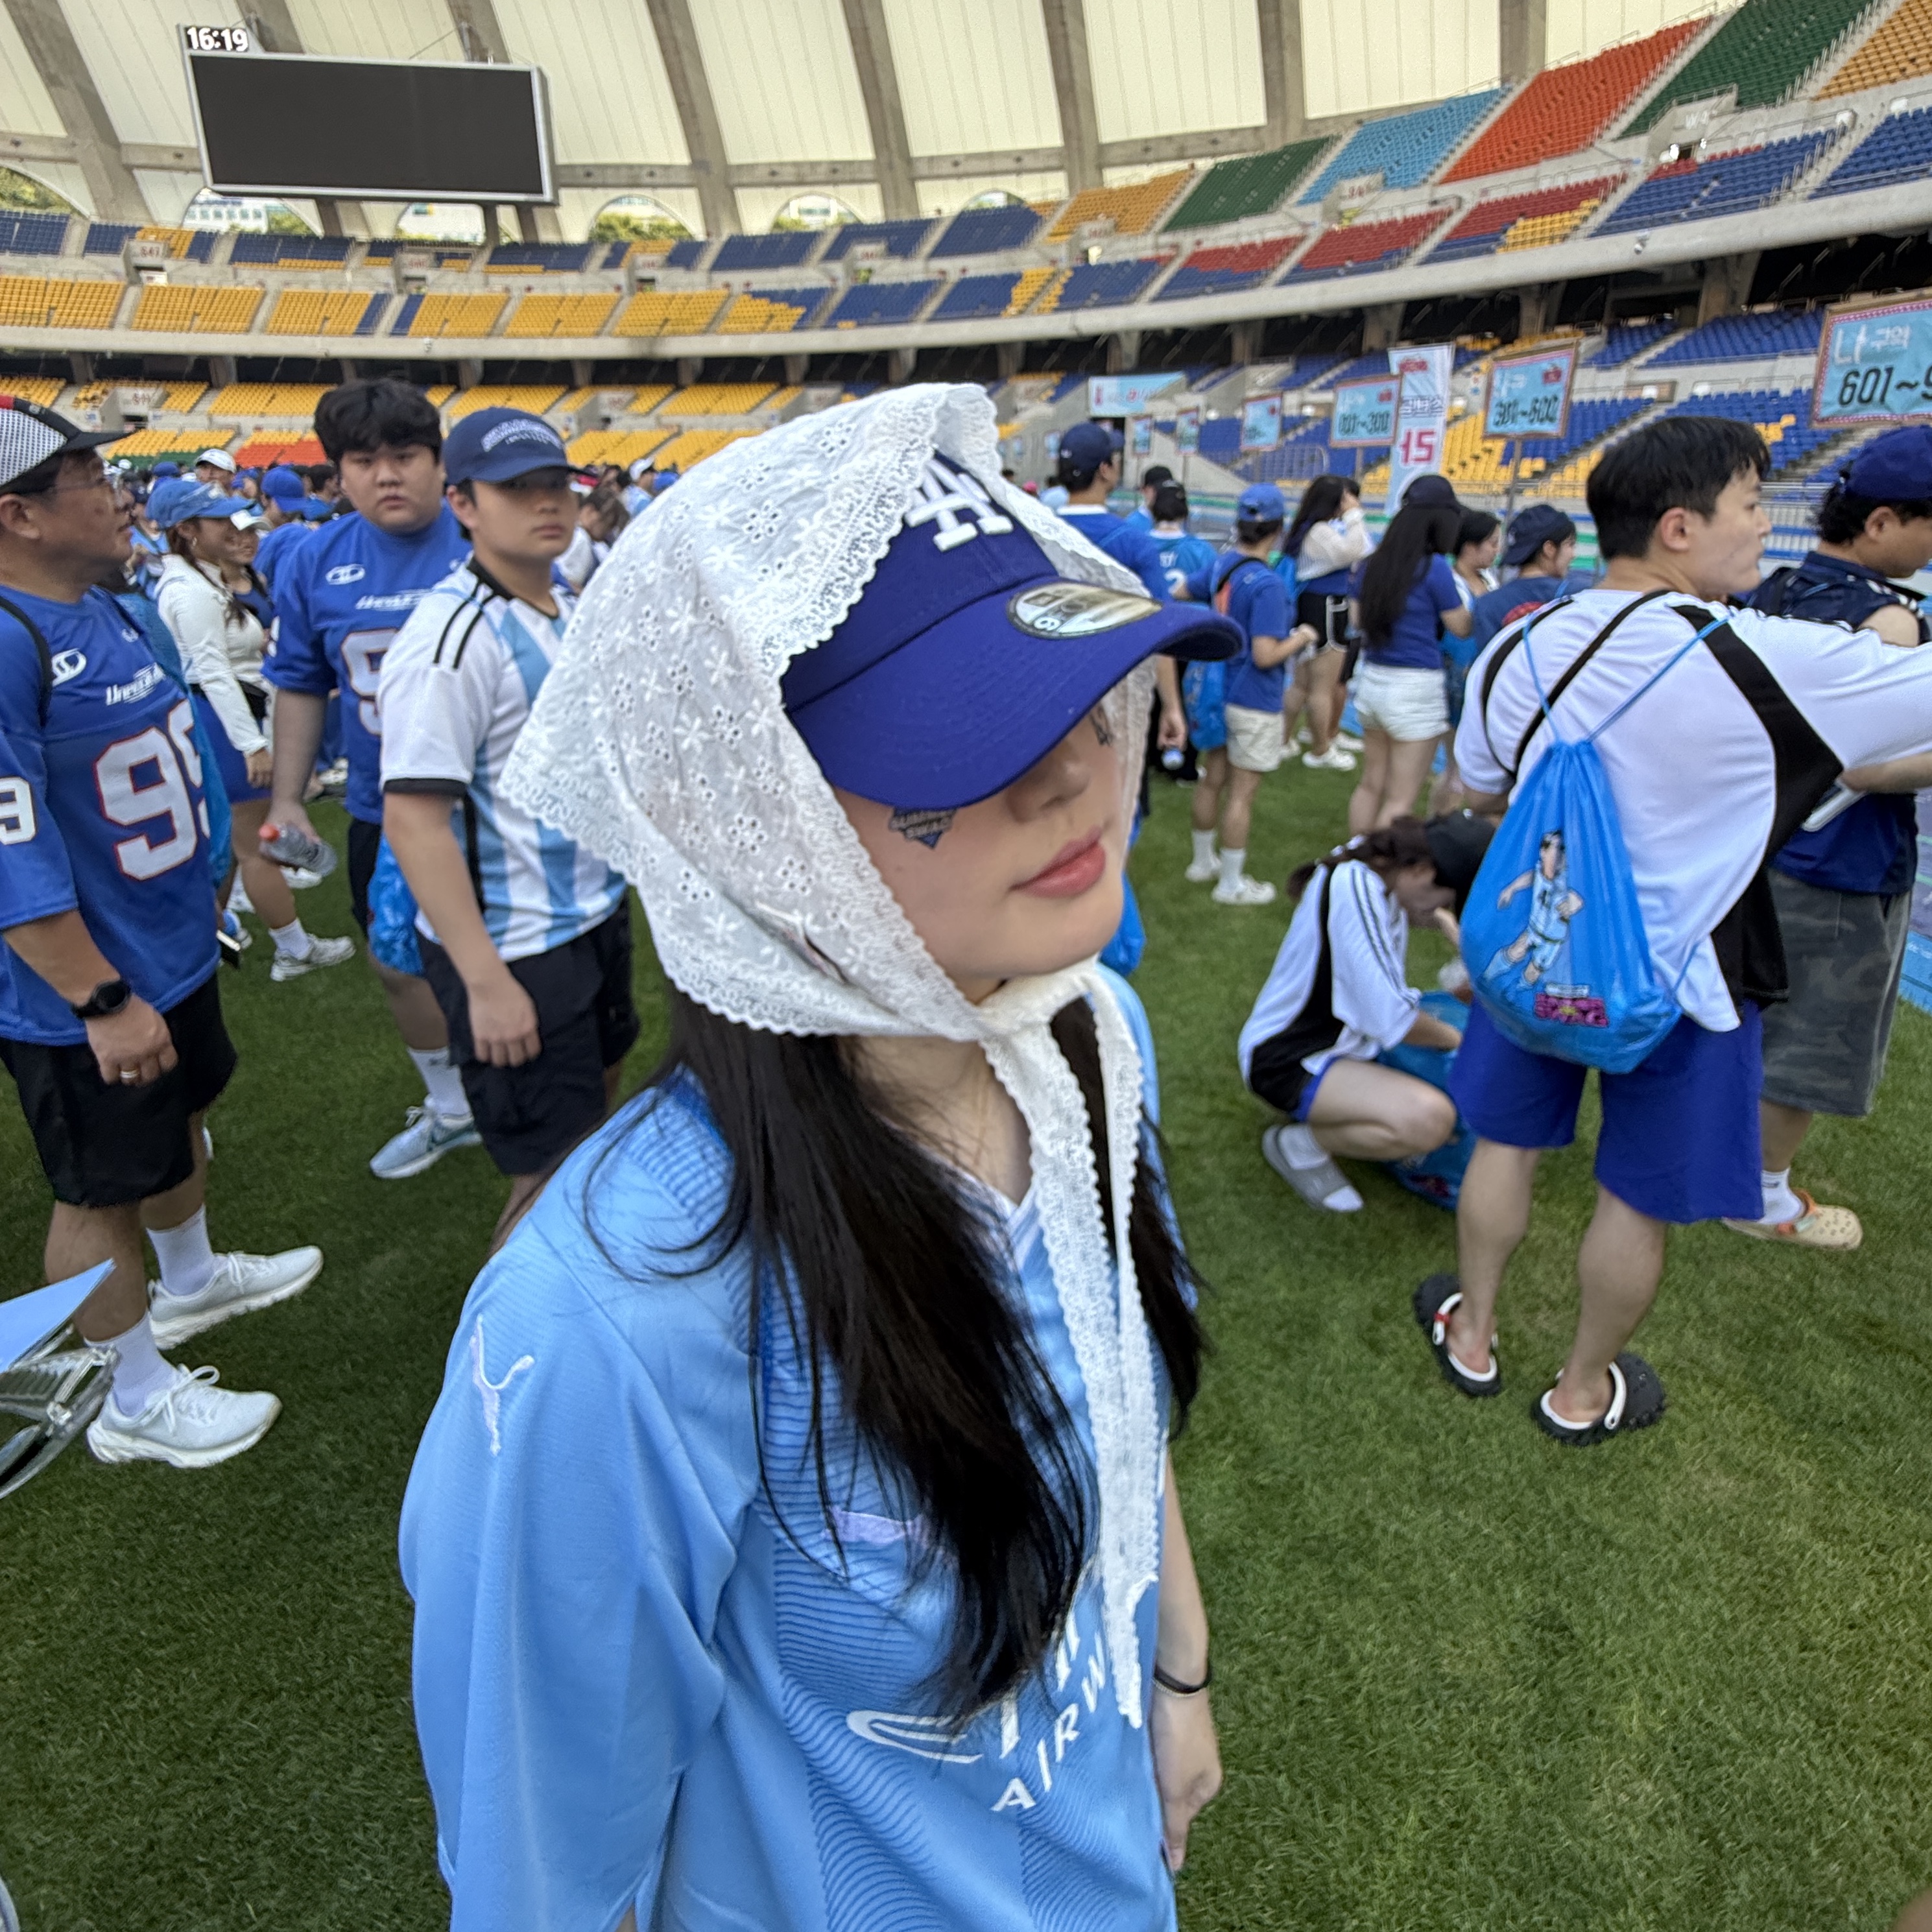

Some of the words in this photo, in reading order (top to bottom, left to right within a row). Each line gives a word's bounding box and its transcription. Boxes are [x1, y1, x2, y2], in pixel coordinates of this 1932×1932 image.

[187, 27, 248, 51] 16:19
[1833, 324, 1867, 366] 나
[1400, 431, 1435, 464] 15
